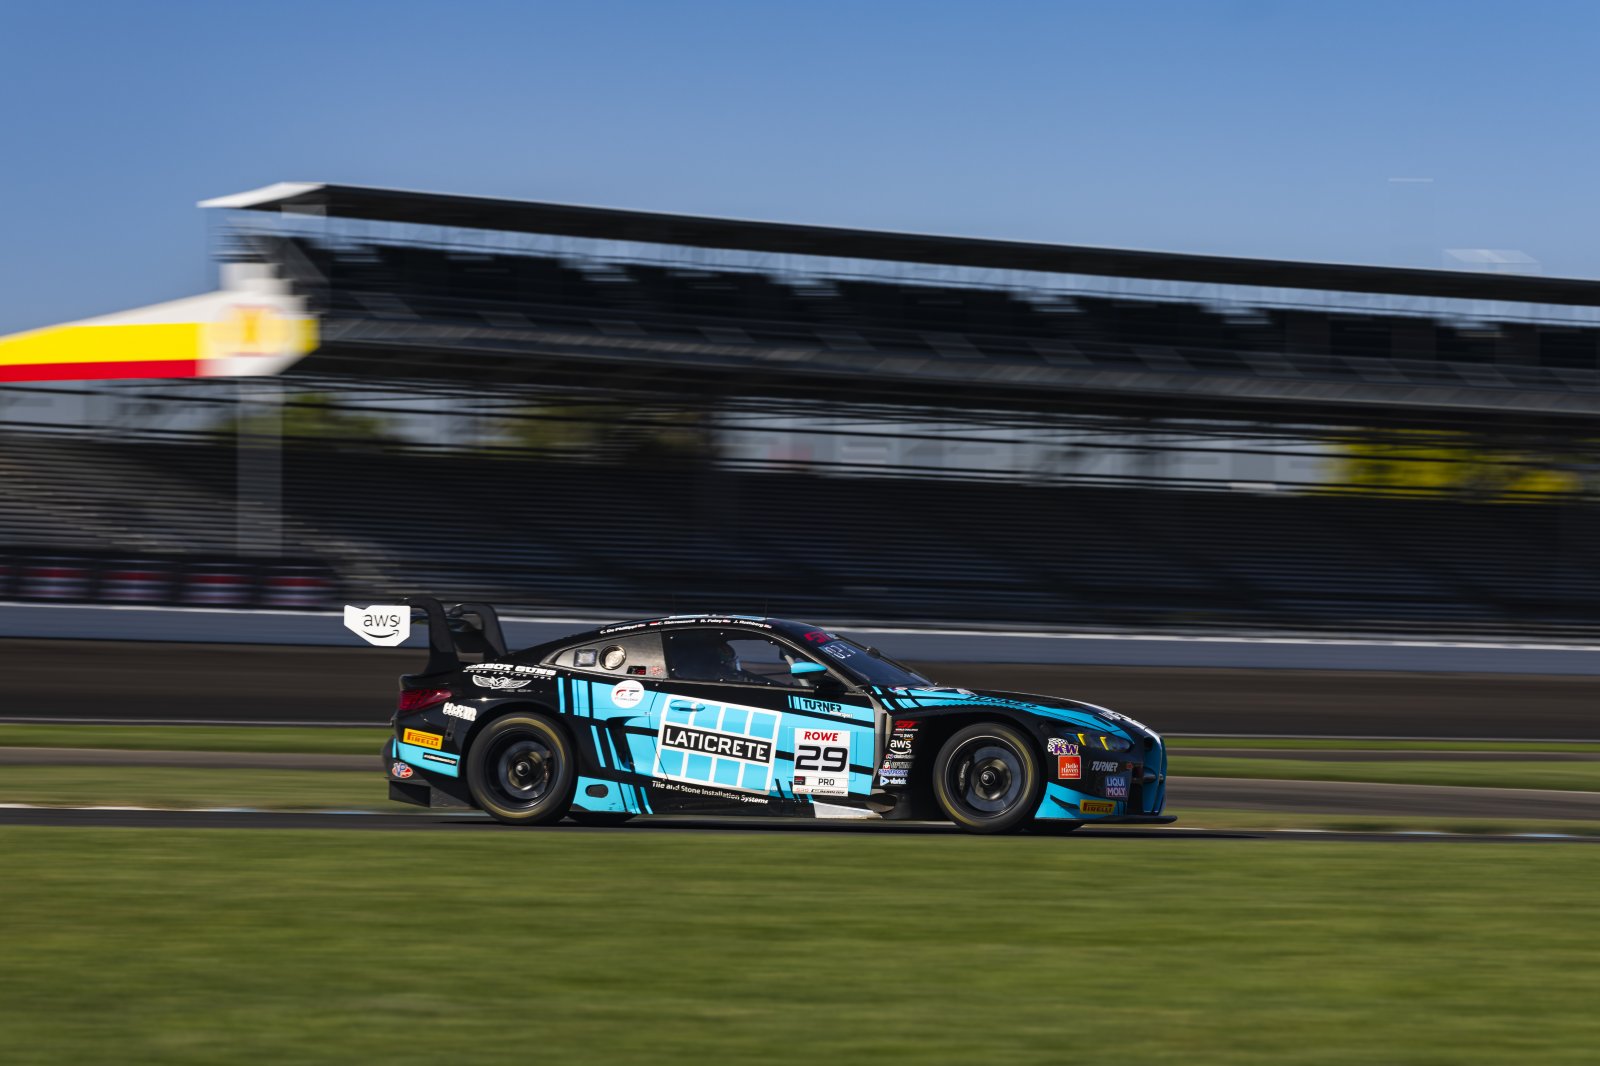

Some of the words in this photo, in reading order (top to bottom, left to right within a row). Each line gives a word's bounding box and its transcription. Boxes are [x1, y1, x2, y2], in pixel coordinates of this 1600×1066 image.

[363, 614, 399, 628] aws
[802, 698, 842, 713] TURNER
[407, 731, 440, 747] PIRELLI
[804, 731, 839, 742] ROWE
[665, 728, 768, 761] LATICRETE
[890, 739, 912, 748] aws
[795, 744, 848, 773] 29
[1091, 760, 1119, 773] TURNER
[818, 778, 835, 786] PRO
[1106, 777, 1125, 786] LIQUI
[652, 780, 665, 789] Tile
[665, 782, 680, 790] and
[681, 785, 701, 794] Stone
[701, 788, 740, 800] Installation
[741, 794, 769, 804] Systems
[1106, 787, 1126, 796] MOLY
[1083, 802, 1114, 812] PIRELLI
